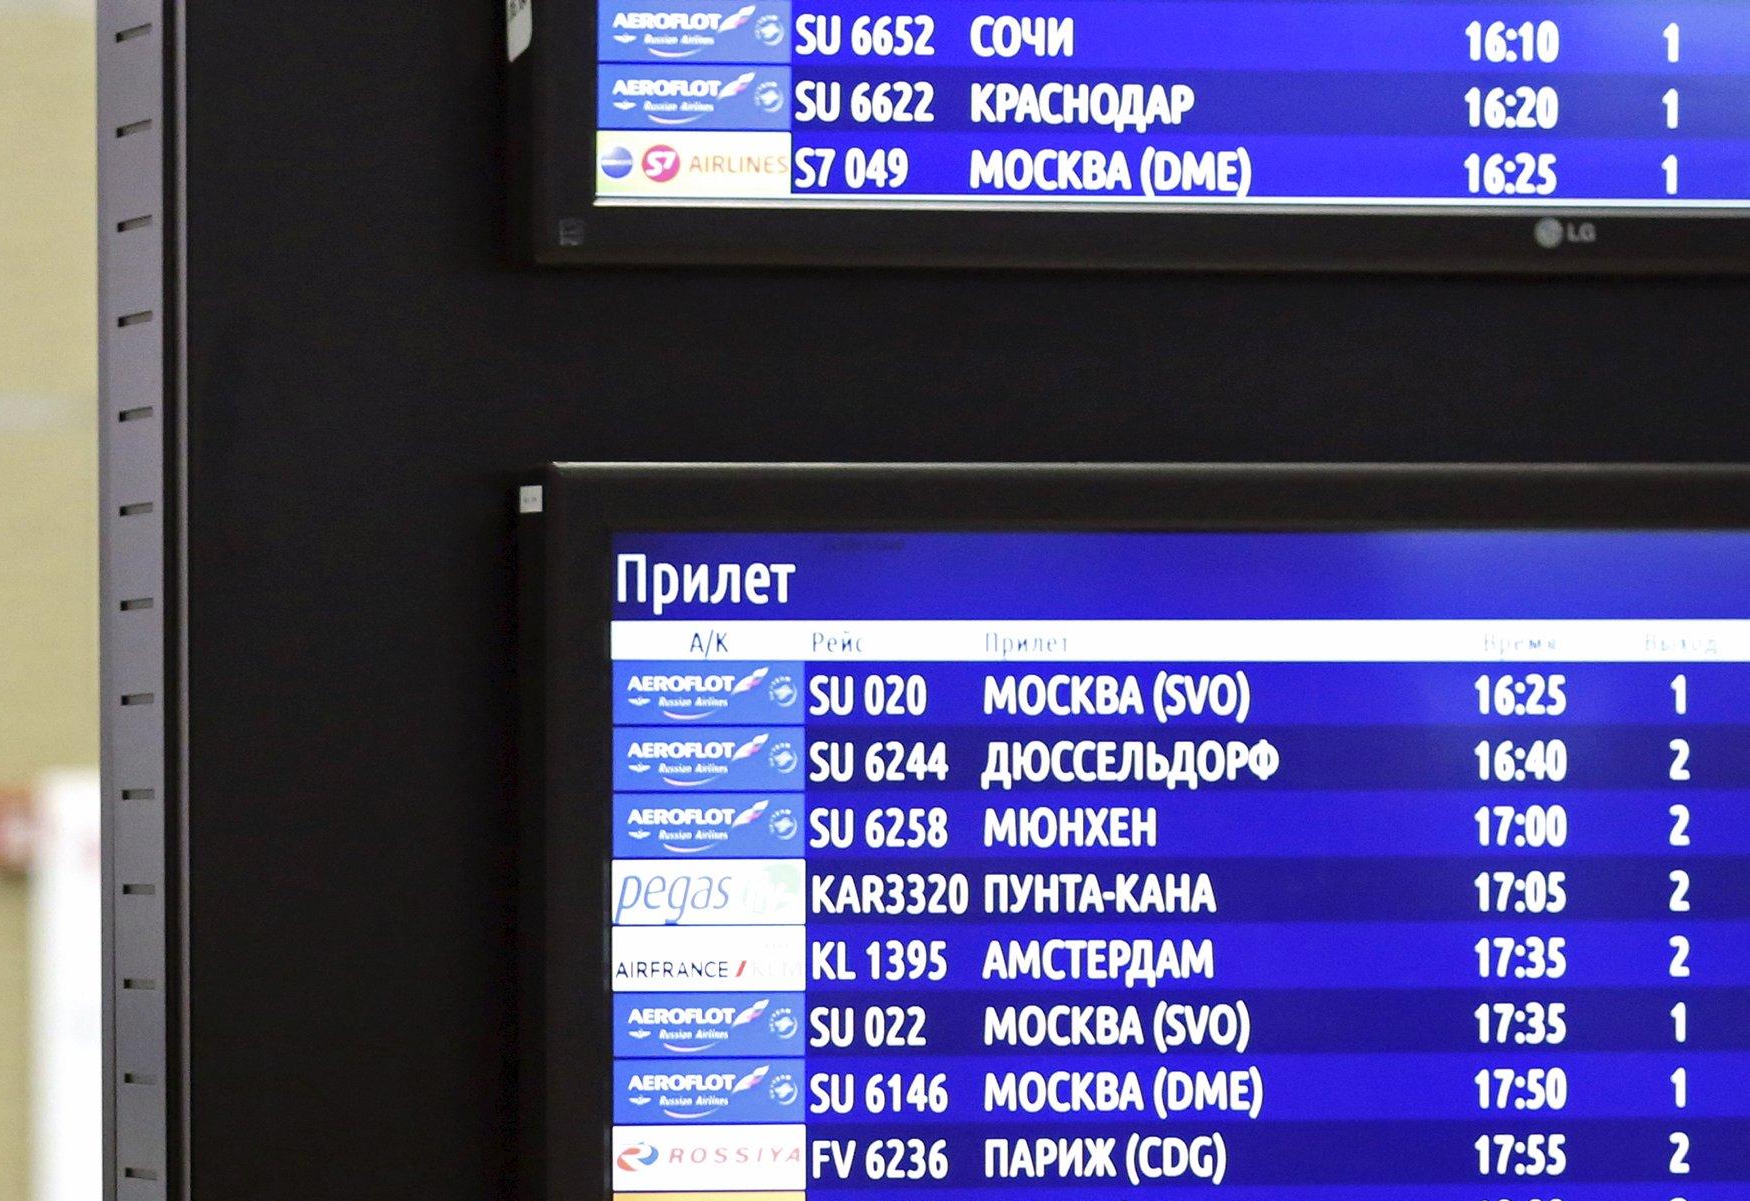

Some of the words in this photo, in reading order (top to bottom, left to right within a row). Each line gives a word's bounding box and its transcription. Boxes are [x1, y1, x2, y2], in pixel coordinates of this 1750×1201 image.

[613, 12, 722, 30] AEROFLOT
[795, 13, 841, 56] SU
[851, 14, 935, 56] 6652
[970, 15, 1074, 58] СОЧИ
[1464, 20, 1560, 64] 16:10
[1662, 23, 1680, 64] 1
[613, 79, 722, 97] AEROFLOT
[794, 80, 841, 122] SU
[850, 81, 935, 123] 6622
[970, 82, 1195, 133] КРАСНОДАР
[1464, 85, 1559, 129] 16:20
[1661, 88, 1679, 129] 1
[646, 151, 676, 177] S7
[689, 155, 790, 174] AIRLINES
[794, 147, 836, 188] S7
[844, 147, 909, 189] 049
[970, 148, 1132, 192] МОСКВА
[1140, 145, 1252, 197] (DME)
[1463, 152, 1558, 195] 16:25
[1661, 154, 1678, 195] 1
[1566, 222, 1597, 243] LG
[617, 553, 796, 615] Прилет
[811, 630, 866, 653] Рейс
[627, 675, 736, 693] AEROFLOT
[809, 674, 854, 716] SU
[864, 674, 927, 716] 020
[983, 674, 1145, 716] МОСКВА
[1153, 670, 1251, 724] (SVO)
[1474, 673, 1567, 716] 16:25
[1670, 674, 1687, 715] 1
[627, 742, 736, 760] AEROFLOT
[809, 741, 854, 782] SU
[864, 741, 949, 782] 6244
[980, 738, 1280, 790] ДЮССЕЛЬДОРФ
[1474, 738, 1568, 782] 16:40
[1669, 738, 1691, 781] 2
[627, 808, 736, 826] AEROFLOT
[809, 807, 854, 849] SU
[865, 807, 948, 848] 6258
[983, 806, 1157, 848] МЮНХЕН
[1474, 804, 1568, 848] 17:00
[1669, 804, 1691, 846] 2
[613, 875, 732, 925] pegas
[812, 873, 969, 915] KAR3320
[984, 873, 1217, 914] ПУНТА-КАНА
[1474, 870, 1567, 913] 17:05
[1669, 869, 1690, 912] 2
[615, 960, 729, 979] AIRFRANCE
[812, 941, 857, 980] KL
[866, 939, 947, 981] 1395
[982, 938, 1214, 989] АМСТЕРДАМ
[1474, 936, 1567, 979] 17:35
[1669, 935, 1690, 977] 2
[627, 1007, 736, 1025] AEROFLOT
[809, 1006, 854, 1048] SU
[864, 1005, 927, 1048] 022
[984, 1004, 1145, 1047] МОСКВА
[1153, 999, 1251, 1054] (SVO)
[1474, 1001, 1567, 1045] 17:35
[1670, 1001, 1686, 1043] 1
[627, 1074, 736, 1092] AEROFLOT
[810, 1072, 854, 1114] SU
[865, 1073, 949, 1114] 6146
[984, 1071, 1145, 1113] МОСКВА
[1153, 1065, 1263, 1120] (DME)
[1474, 1067, 1567, 1110] 17:50
[1670, 1067, 1686, 1108] 1
[668, 1147, 801, 1164] ROSSIYA
[812, 1140, 857, 1179] FV
[865, 1138, 949, 1180] 6236
[984, 1137, 1117, 1178] ПАРИЖ
[1125, 1132, 1227, 1186] (CDG)
[1474, 1133, 1567, 1176] 17:55
[1669, 1131, 1690, 1174] 2
